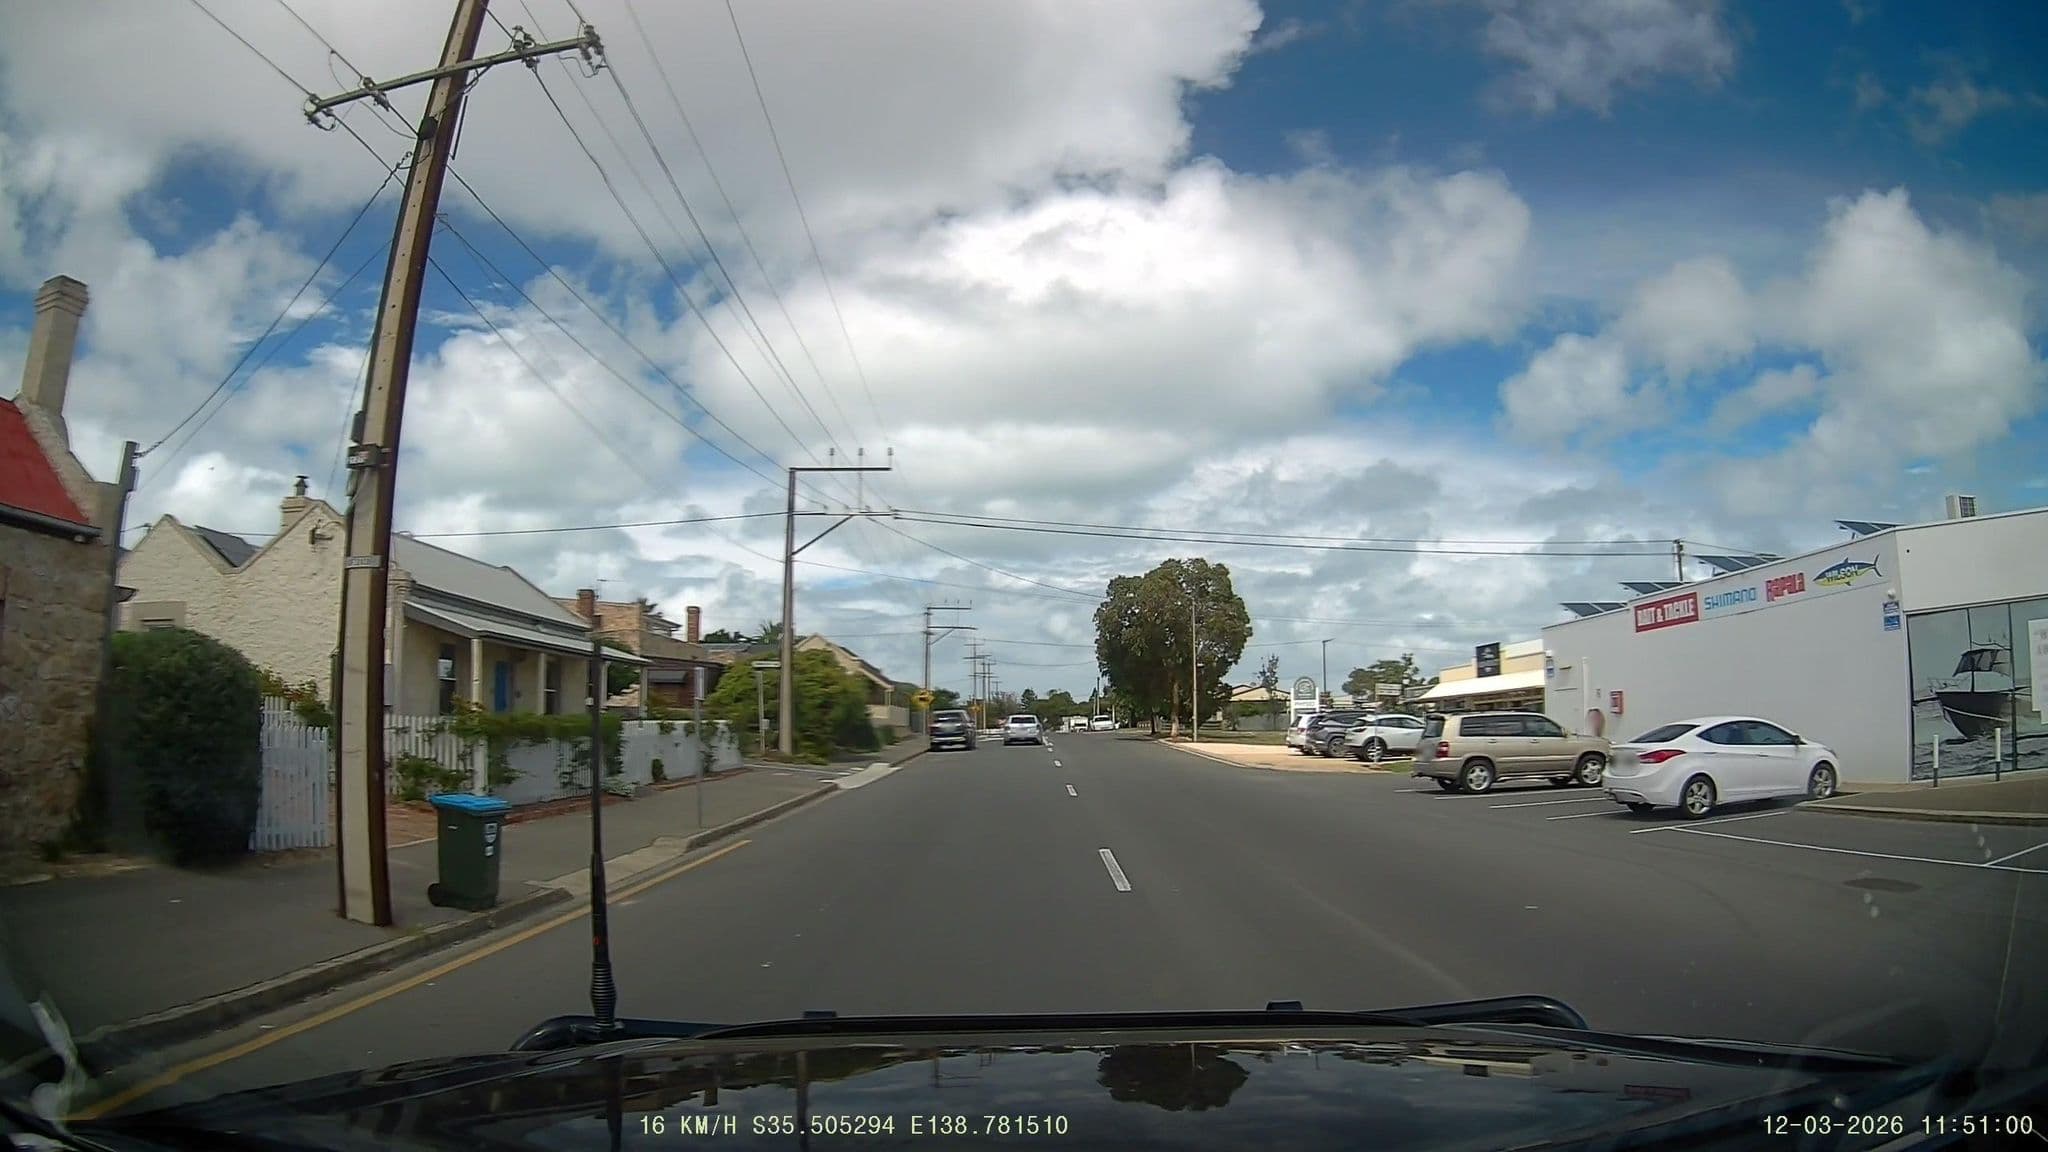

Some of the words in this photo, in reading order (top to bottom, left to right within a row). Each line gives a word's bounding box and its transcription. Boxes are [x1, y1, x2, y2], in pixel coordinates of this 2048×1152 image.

[1825, 564, 1858, 582] WILSON
[1656, 608, 1664, 622] &
[1664, 598, 1696, 621] TACKLE
[1704, 587, 1757, 610] SHIMANO
